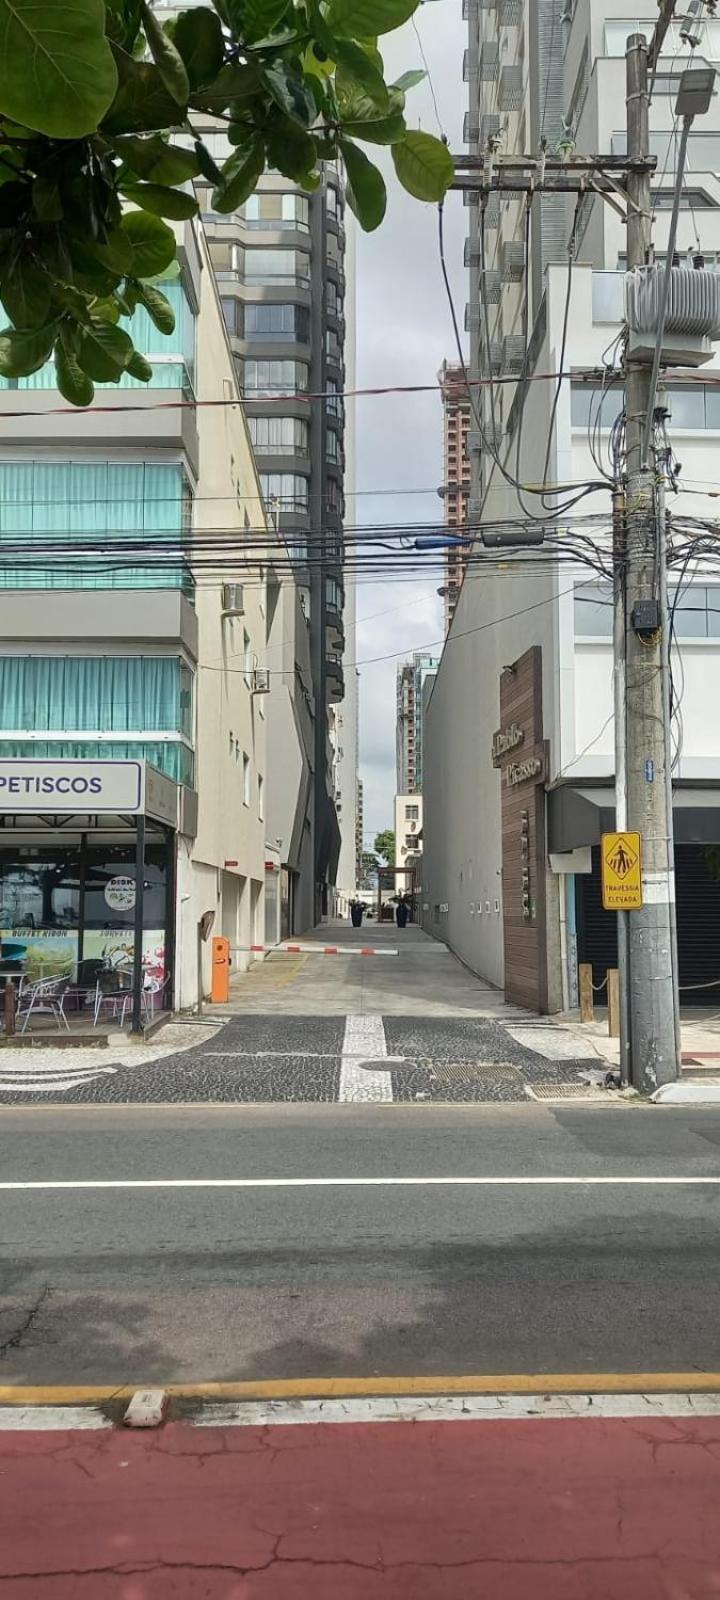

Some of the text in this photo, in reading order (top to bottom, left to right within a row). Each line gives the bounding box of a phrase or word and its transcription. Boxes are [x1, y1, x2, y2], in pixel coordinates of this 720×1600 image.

[506, 757, 542, 787] Picasso
[0, 776, 102, 794] PETISCOS
[605, 884, 640, 892] TRAVESSIA
[607, 895, 638, 903] ELEVADA
[12, 930, 41, 938] BUFFET
